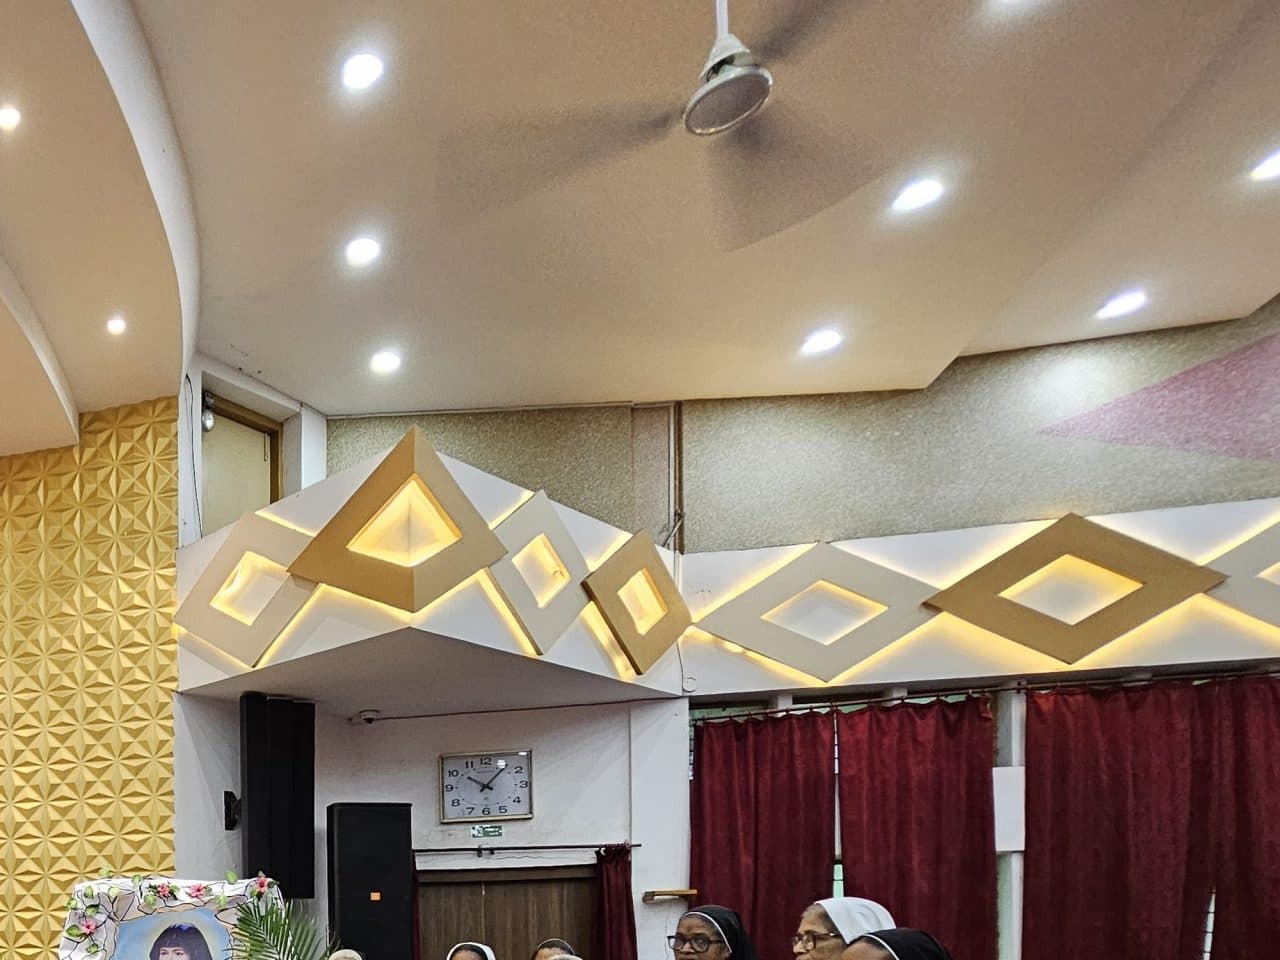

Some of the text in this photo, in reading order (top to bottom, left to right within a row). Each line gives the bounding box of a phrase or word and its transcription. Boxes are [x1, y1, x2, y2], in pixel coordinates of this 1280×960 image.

[465, 760, 474, 769] 11
[480, 757, 492, 766] 12
[448, 769, 459, 777] 10
[514, 766, 523, 774] 2
[519, 780, 528, 788] 3
[451, 799, 460, 807] 8
[512, 796, 521, 804] 4
[466, 807, 475, 815] 7
[482, 807, 491, 816] 6
[498, 806, 508, 814] 5
